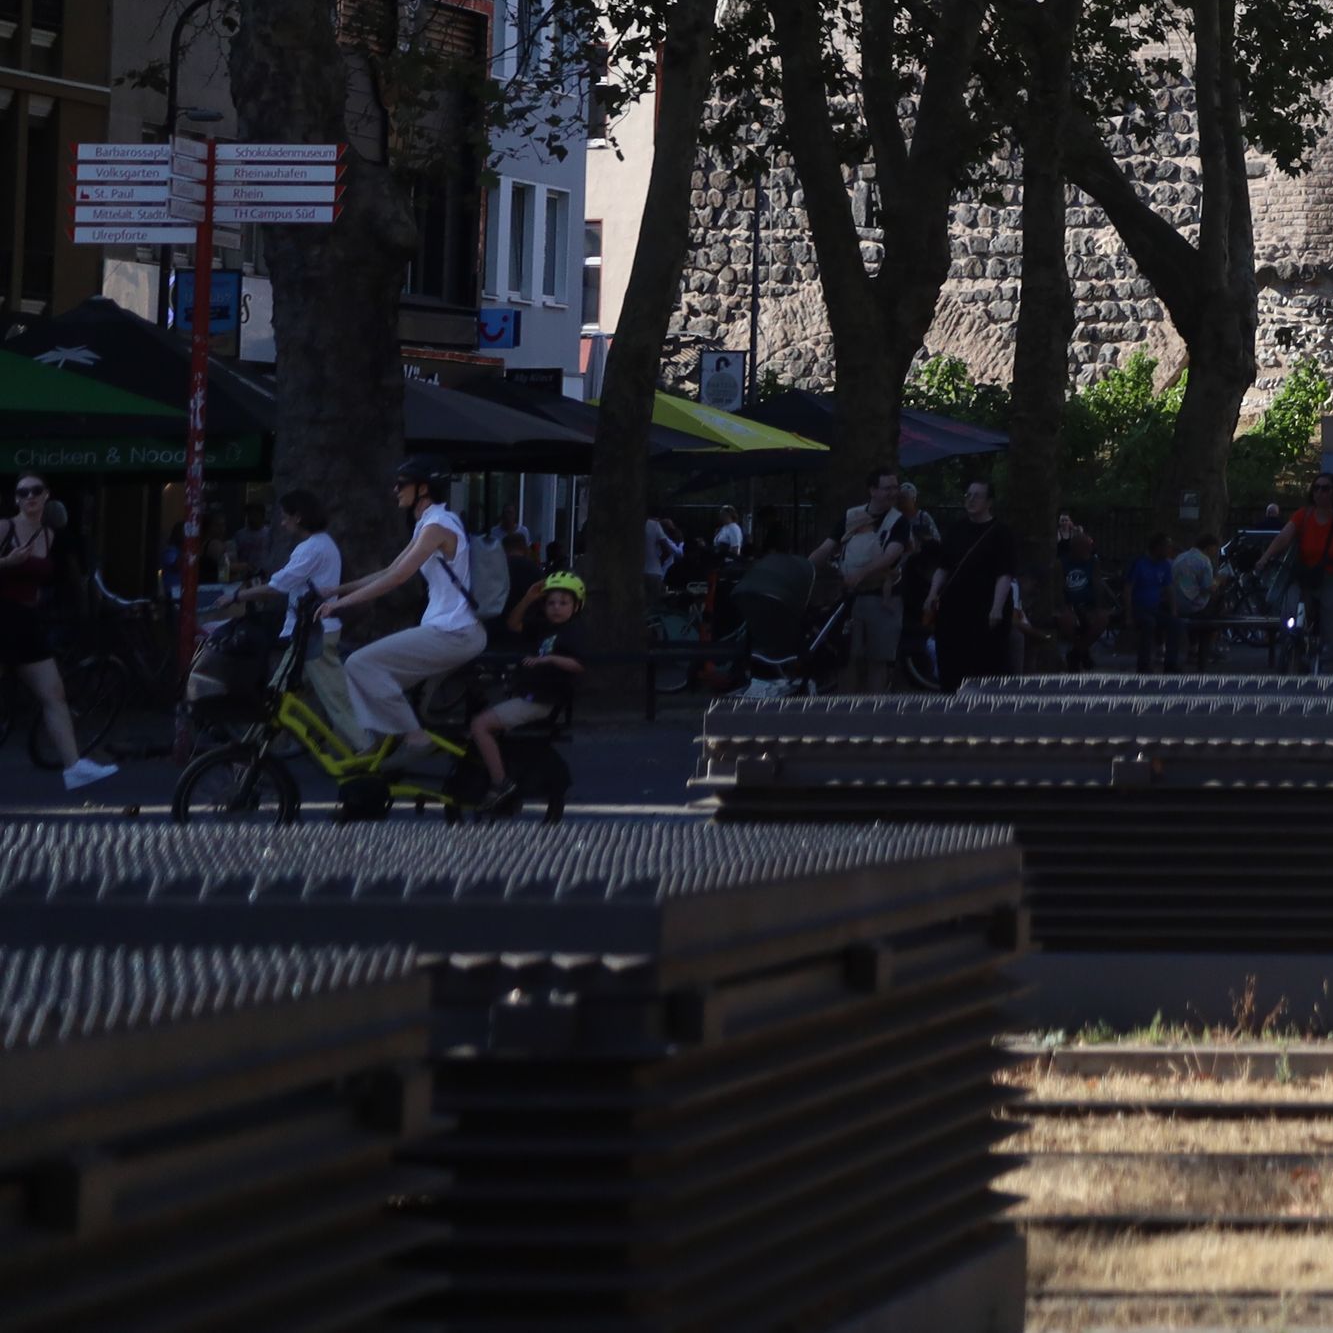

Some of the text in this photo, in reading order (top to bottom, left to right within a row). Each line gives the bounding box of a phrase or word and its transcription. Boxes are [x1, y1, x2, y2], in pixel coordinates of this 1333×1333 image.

[95, 146, 170, 159] Barbarossapla
[235, 146, 335, 158] Schokoladenmuseum
[95, 167, 160, 180] Volksgarten
[233, 167, 308, 179] Rheinauhafen
[94, 188, 135, 199] St. Paul
[232, 187, 264, 199] Rhein
[232, 207, 317, 221] TH Campus Süd
[91, 229, 148, 242] Ulrepforte
[14, 447, 216, 466] Chicken & Noods
